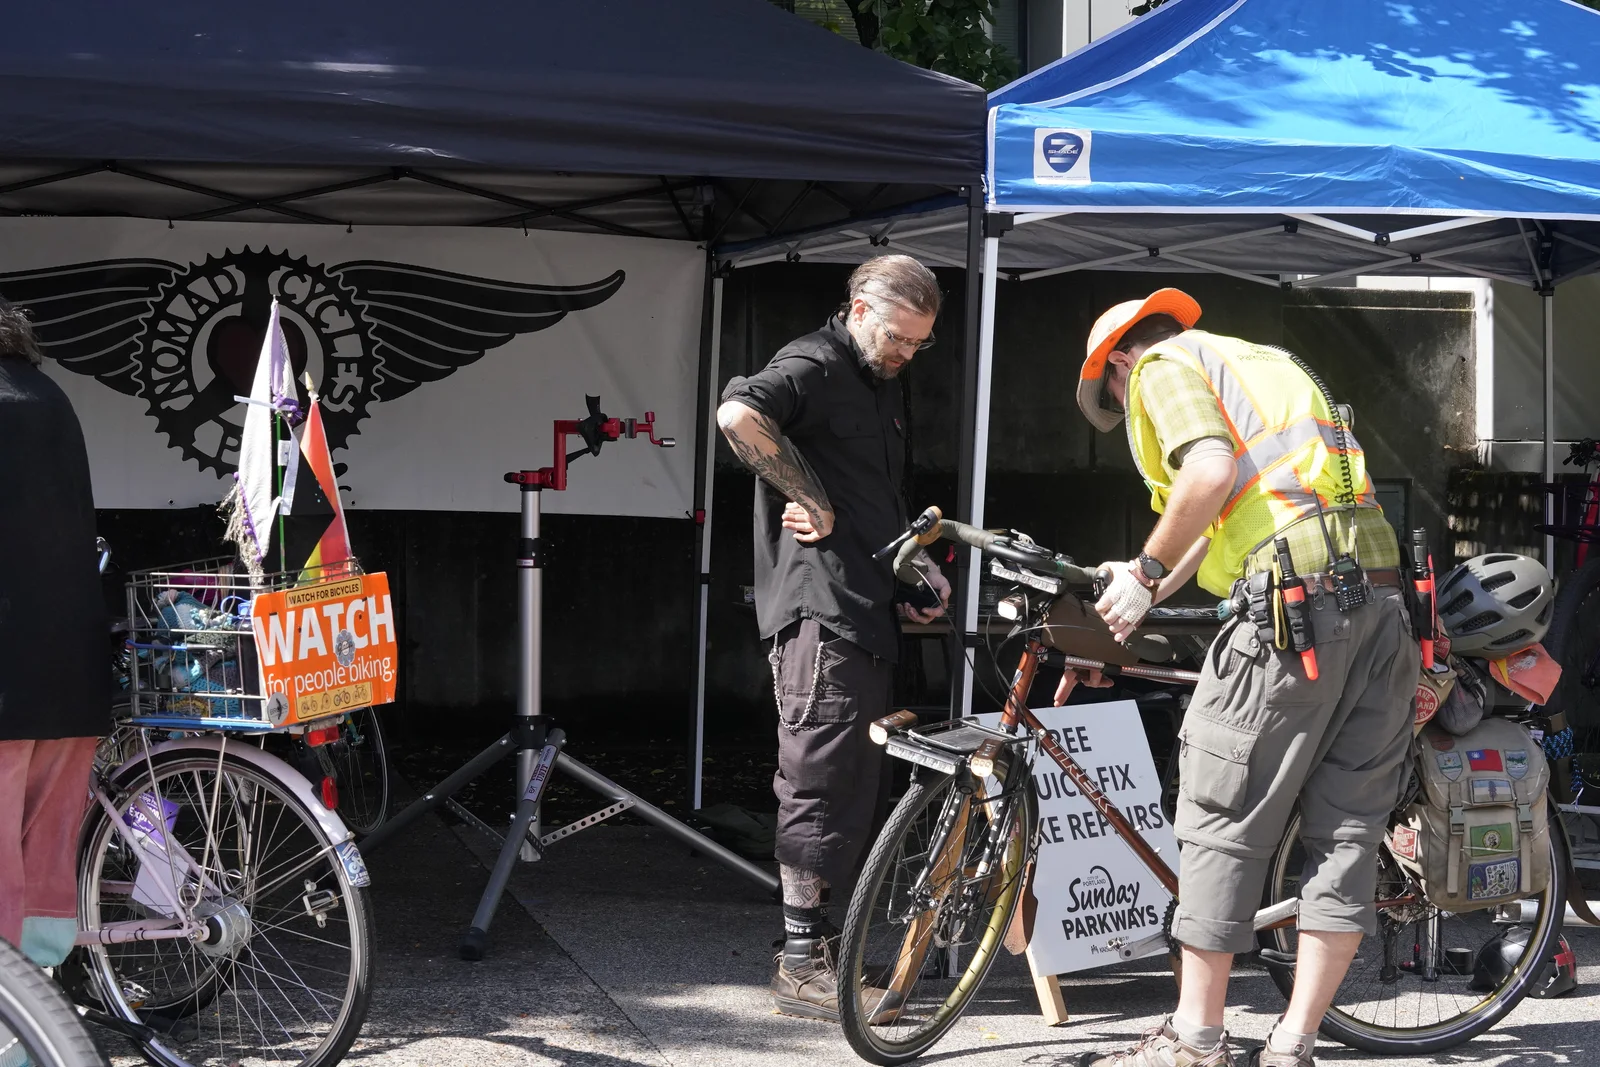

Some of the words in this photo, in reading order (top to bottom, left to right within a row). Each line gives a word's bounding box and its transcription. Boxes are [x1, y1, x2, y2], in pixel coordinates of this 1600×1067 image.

[151, 264, 247, 411] NOMAD
[268, 265, 364, 413] CYCLES
[289, 593, 315, 604] WATCH
[316, 589, 330, 599] FOR
[330, 583, 360, 596] BICYCLES
[254, 593, 396, 667] WATCH
[267, 673, 291, 697] for
[294, 661, 346, 698] people
[350, 655, 395, 683] biking.
[1067, 803, 1164, 841] REPIRS
[1067, 865, 1140, 913] Sunday
[1083, 879, 1106, 887] PORTLAND
[1061, 904, 1159, 940] PARKWAYS
